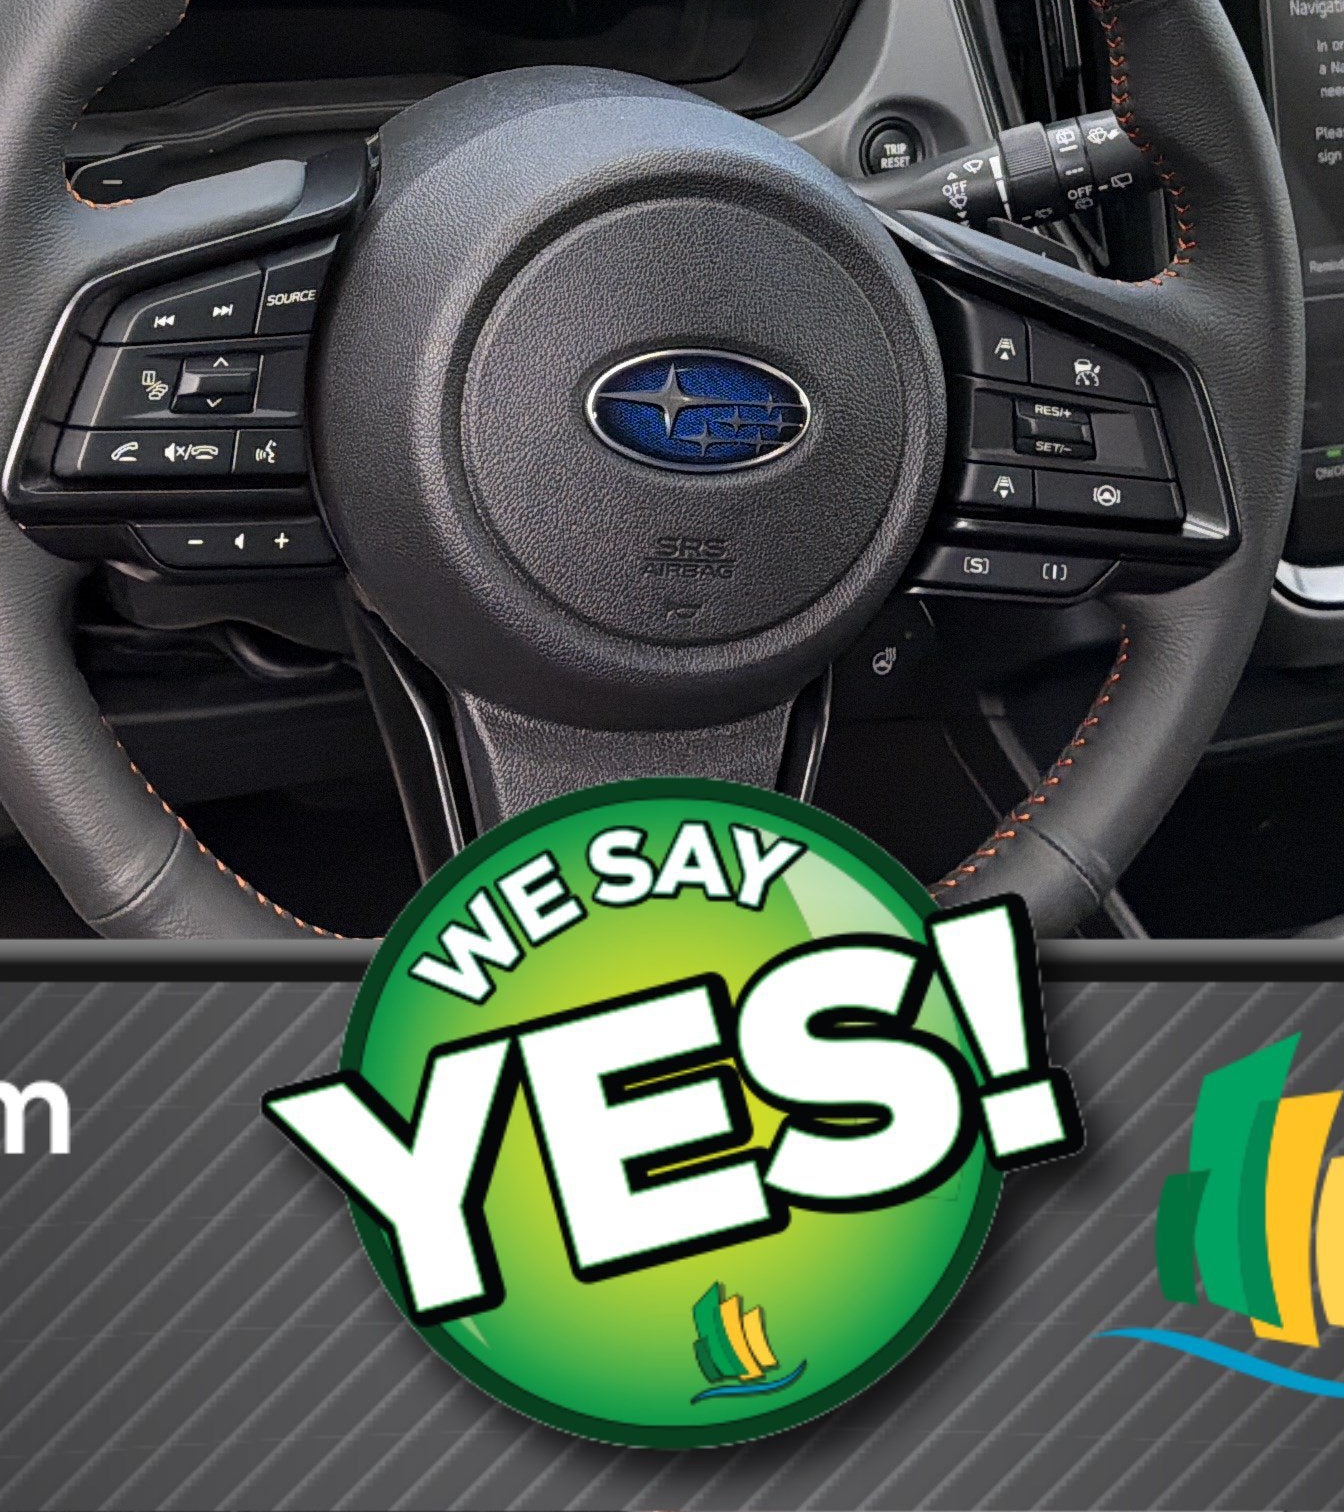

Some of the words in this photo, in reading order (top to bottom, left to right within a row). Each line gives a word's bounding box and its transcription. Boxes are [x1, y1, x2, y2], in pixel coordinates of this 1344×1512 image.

[1317, 39, 1329, 53] In
[1318, 64, 1327, 76] a
[883, 142, 907, 156] TRIP
[1317, 148, 1343, 166] sign
[880, 155, 911, 170] RESET
[941, 180, 968, 197] OFF
[1067, 184, 1093, 201] OFF
[266, 289, 317, 307] SOURCE
[1034, 404, 1072, 418] RES/+
[657, 535, 730, 559] SRS
[642, 562, 734, 580] AIRBAG
